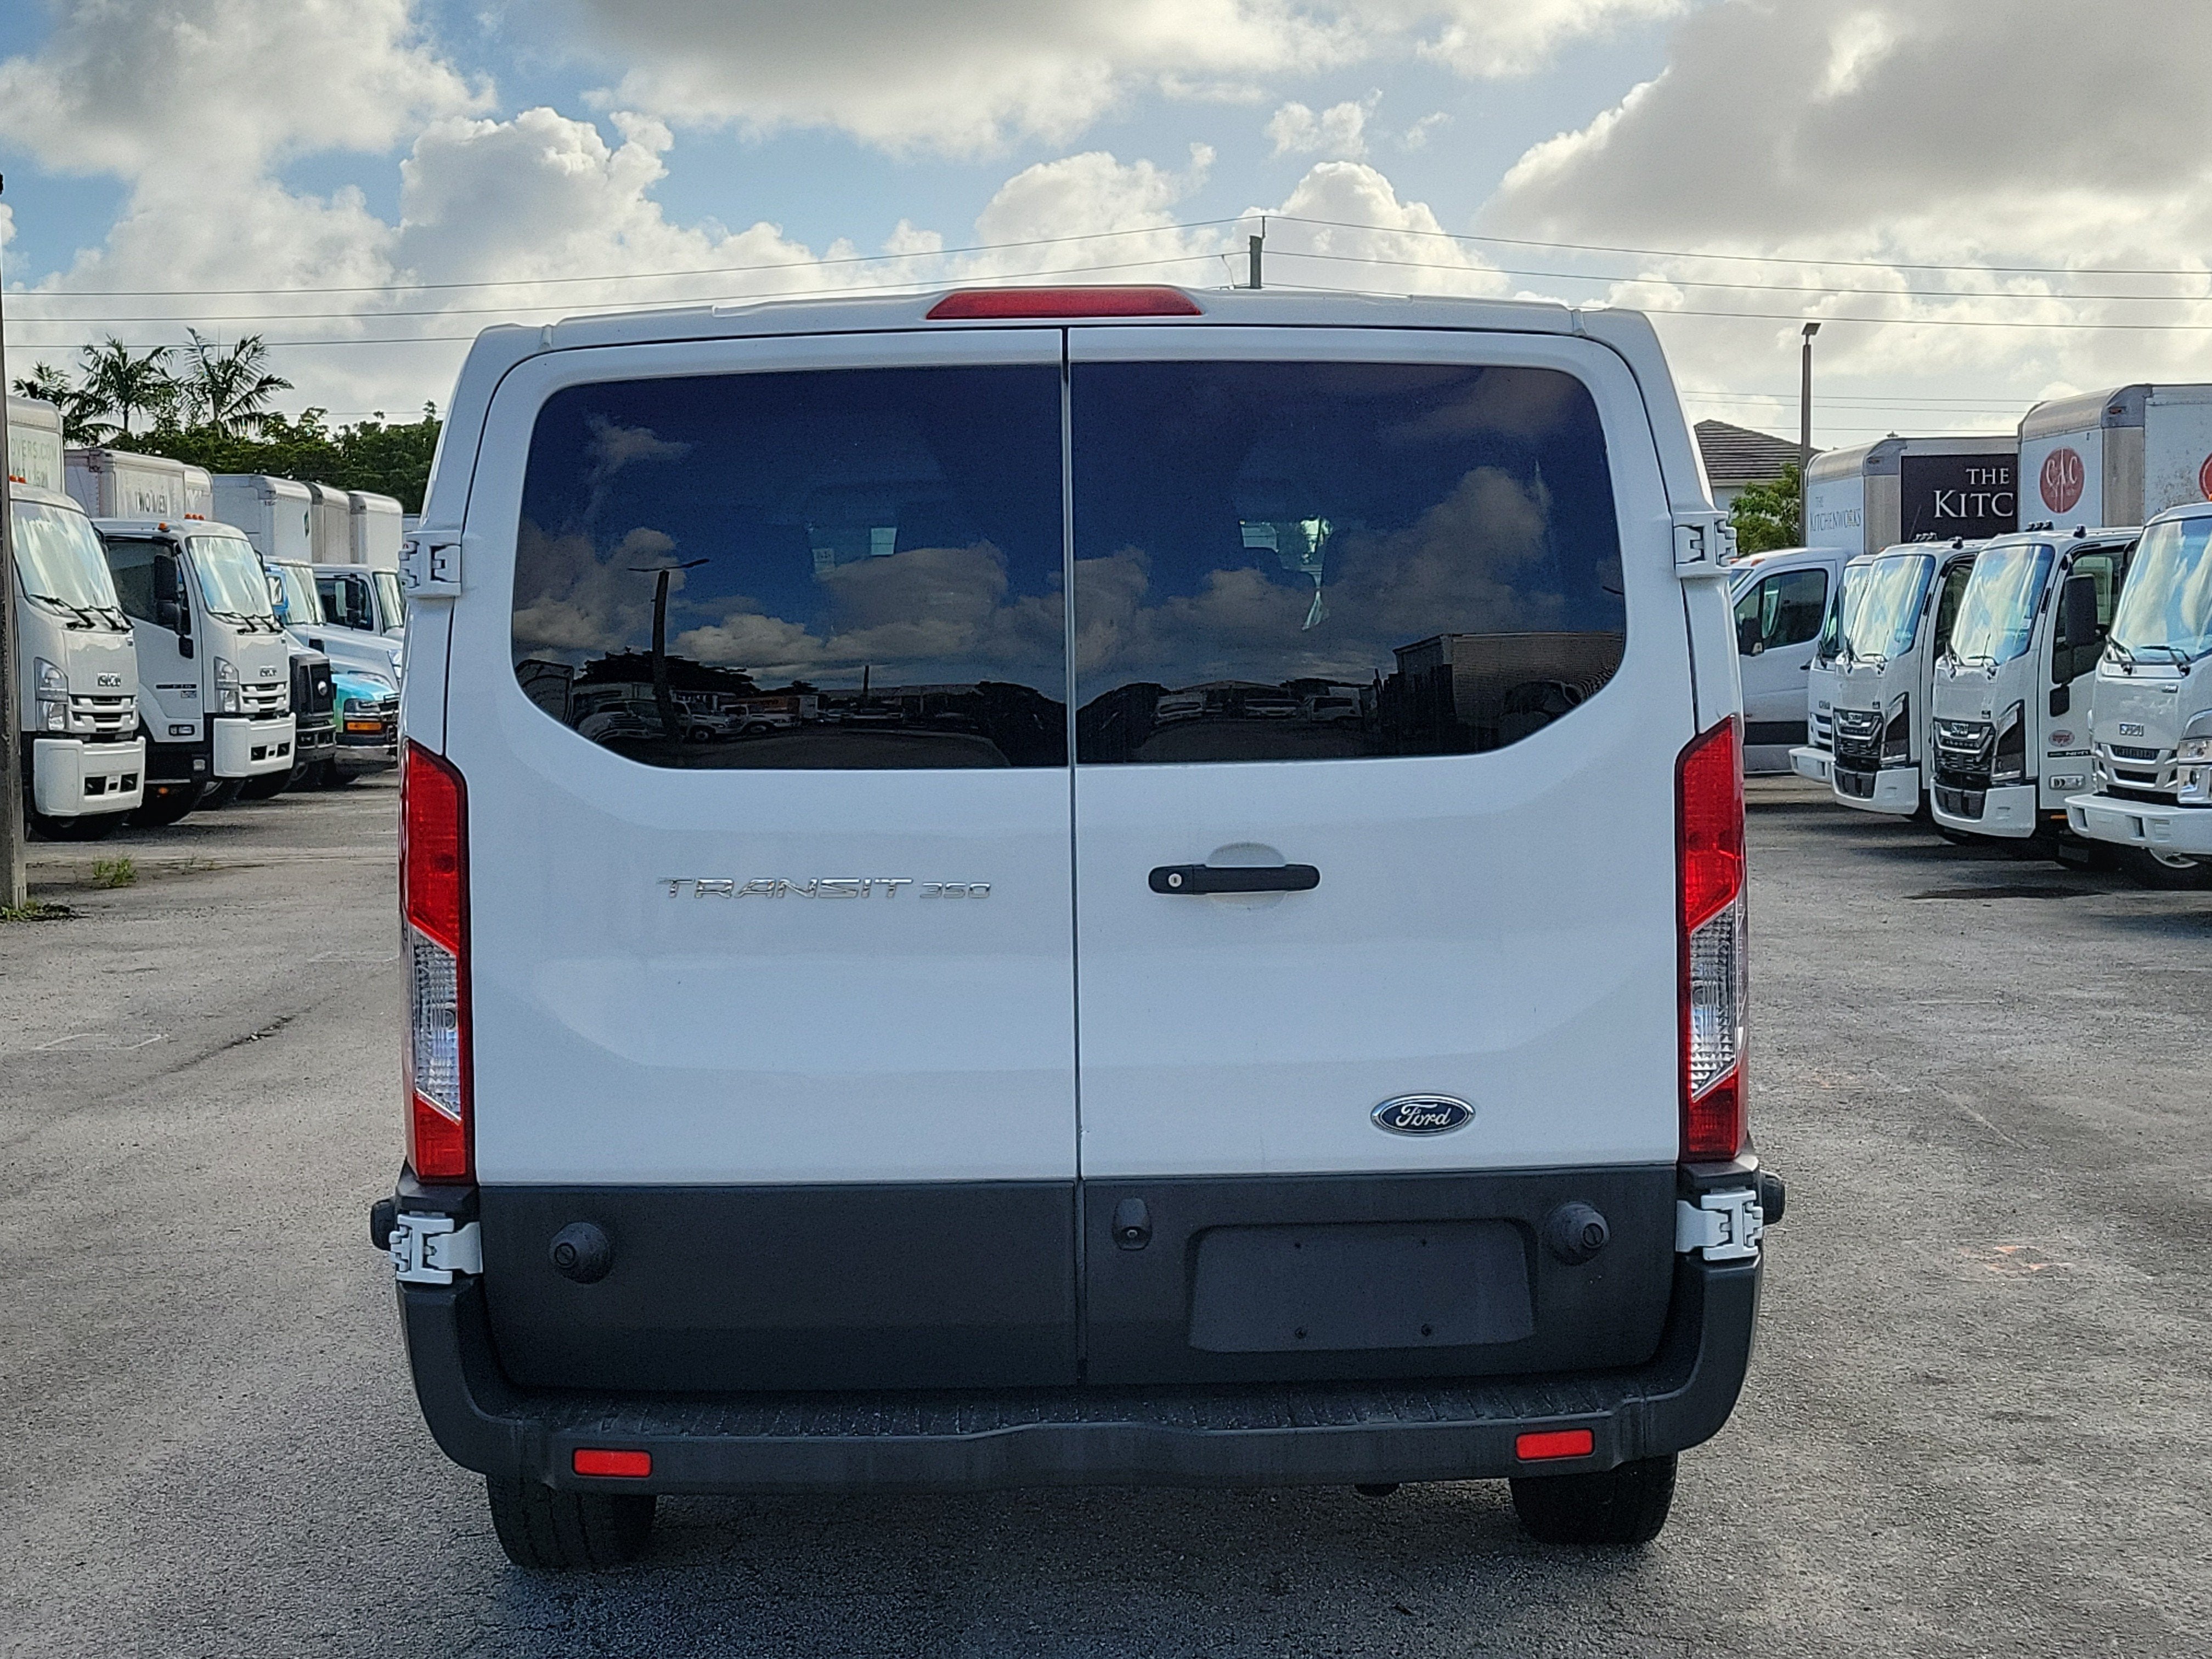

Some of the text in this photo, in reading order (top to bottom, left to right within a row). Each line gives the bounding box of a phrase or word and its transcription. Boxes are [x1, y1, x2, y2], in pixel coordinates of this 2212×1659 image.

[1966, 467, 2010, 485] THE
[1933, 489, 2014, 518] KITC
[658, 878, 991, 899] TRANSIT 350
[1395, 1103, 1452, 1126] Ford
